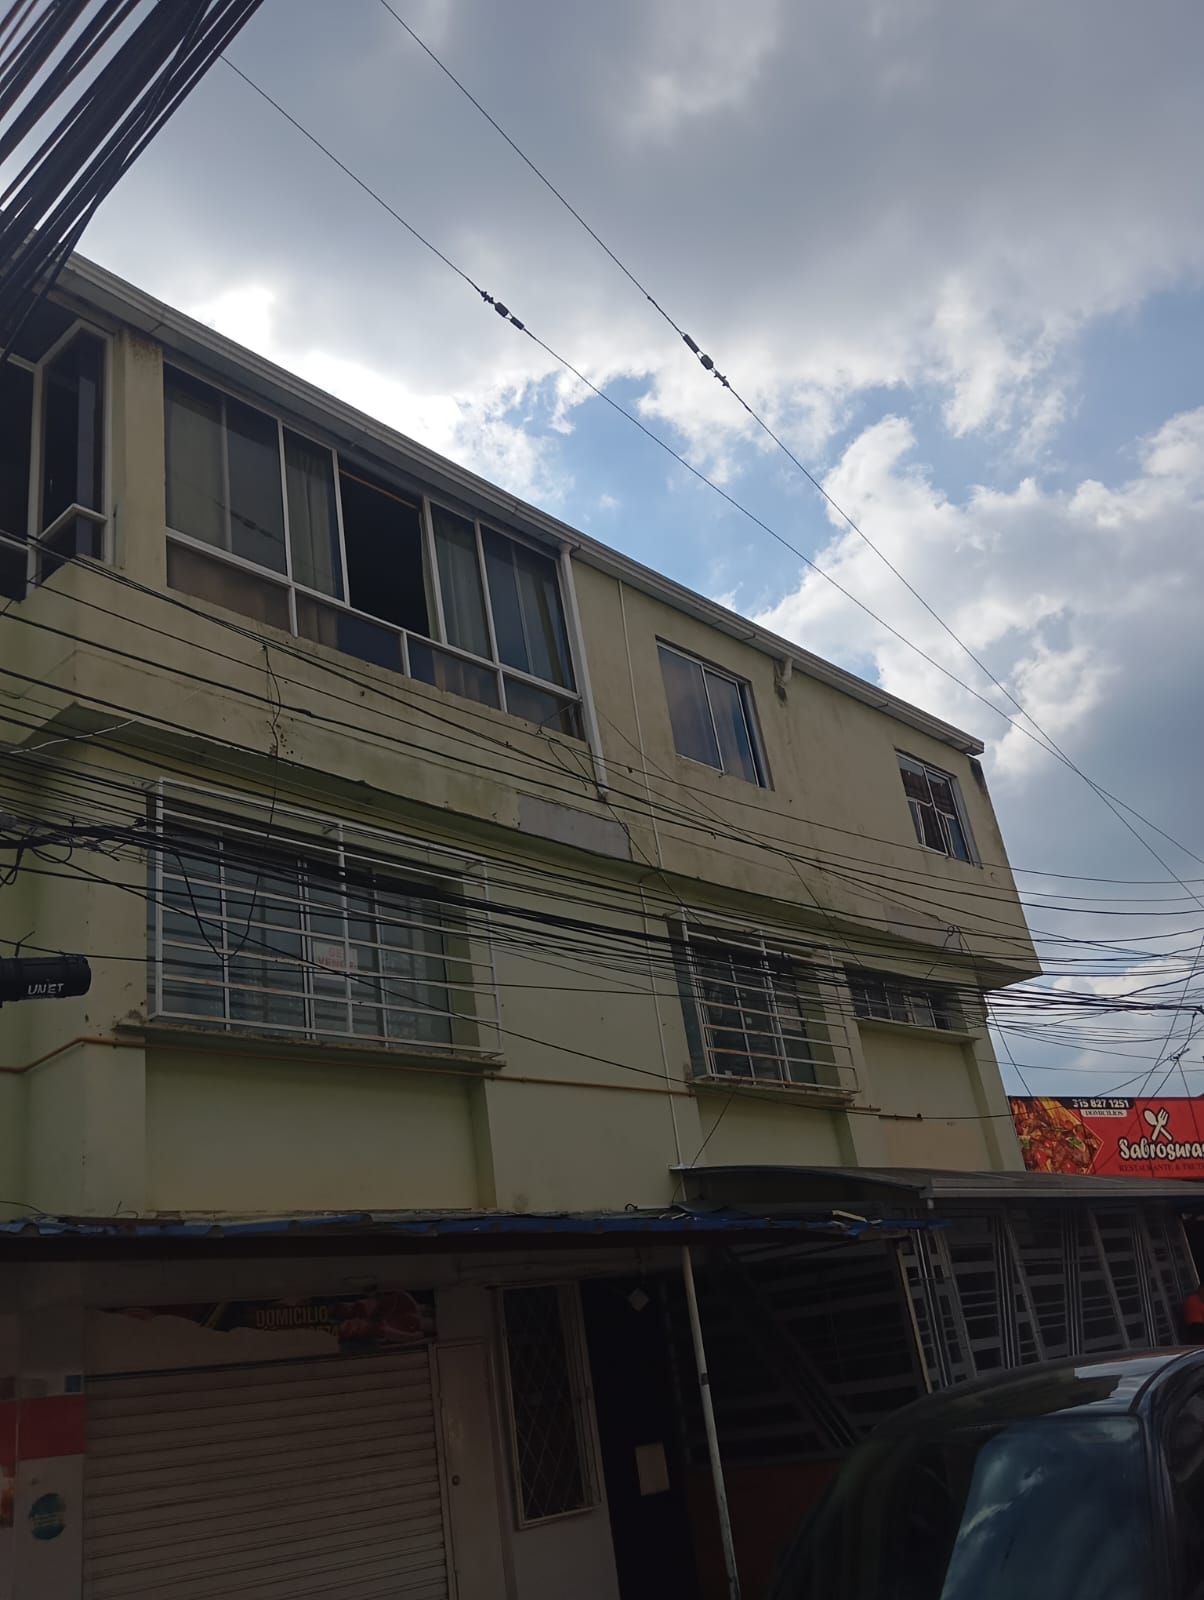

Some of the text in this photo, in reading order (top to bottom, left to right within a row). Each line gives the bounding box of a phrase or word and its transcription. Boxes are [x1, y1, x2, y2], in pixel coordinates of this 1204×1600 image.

[27, 983, 64, 995] UNET
[1072, 1099, 1129, 1108] 315 827 1251
